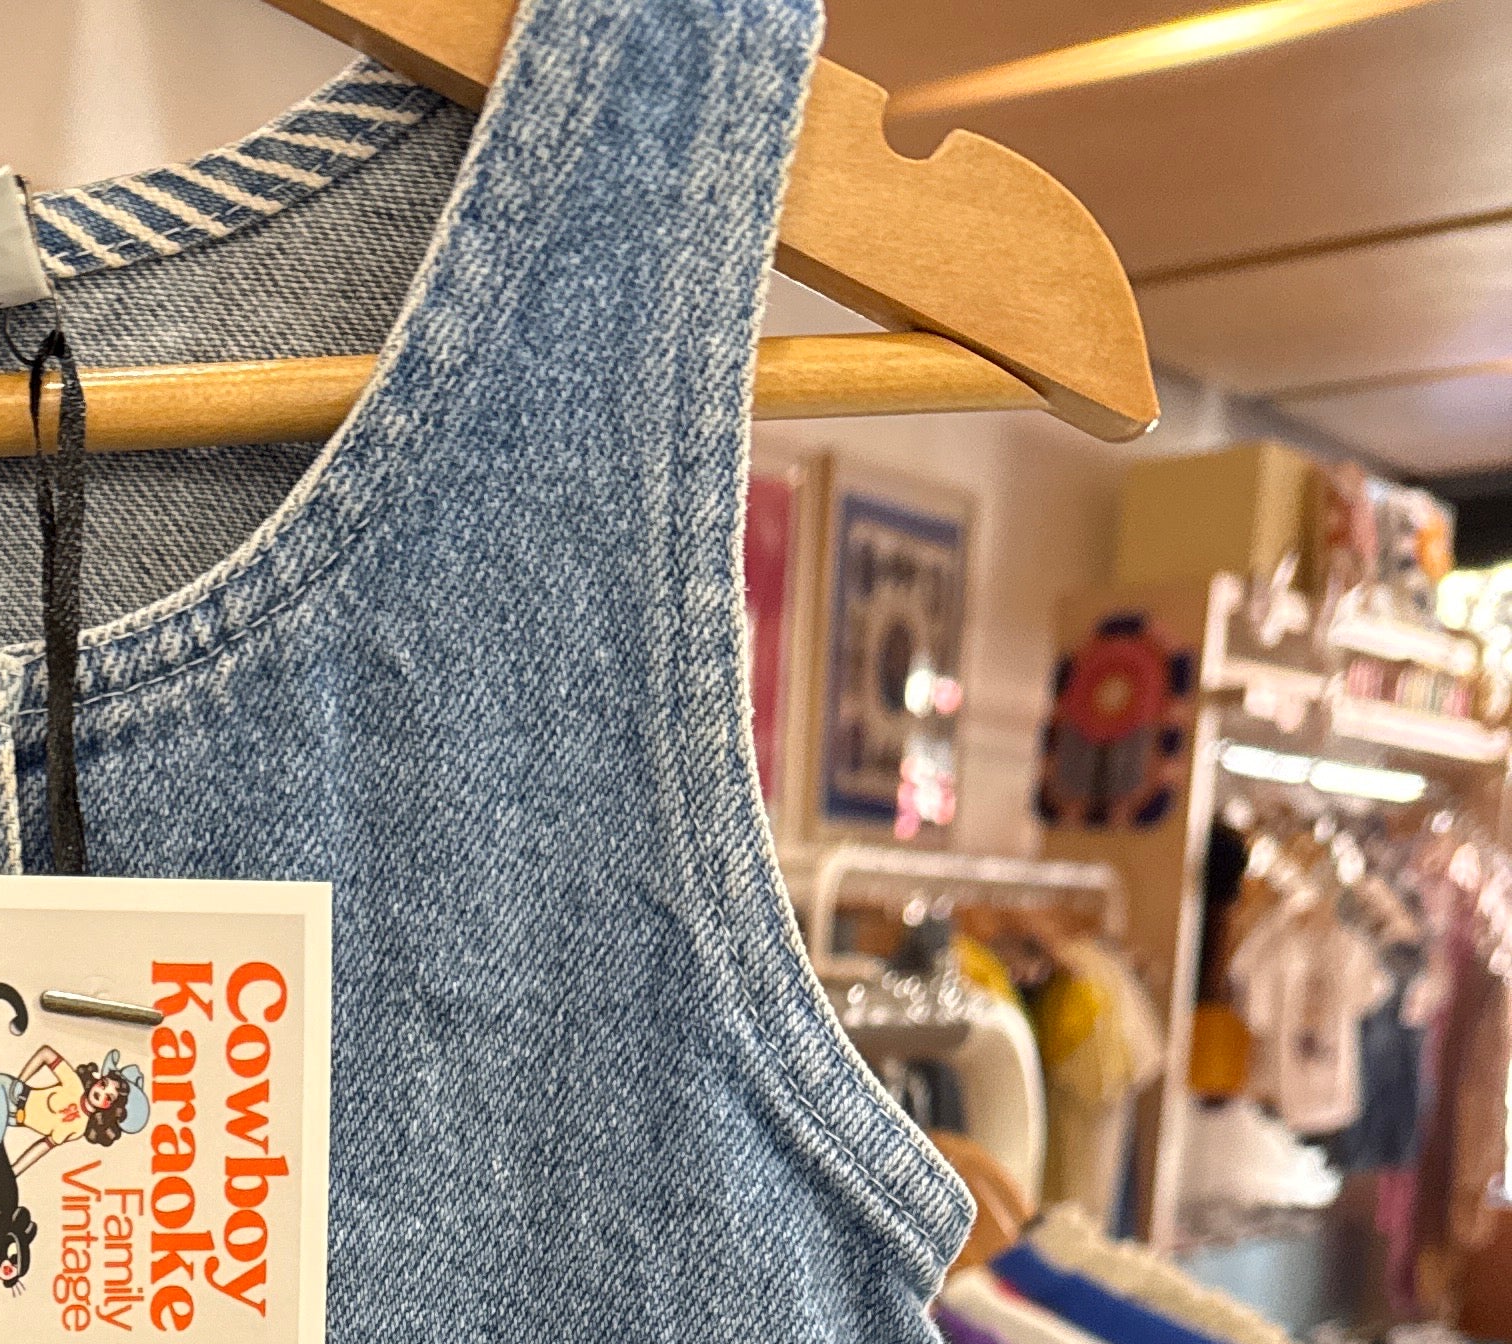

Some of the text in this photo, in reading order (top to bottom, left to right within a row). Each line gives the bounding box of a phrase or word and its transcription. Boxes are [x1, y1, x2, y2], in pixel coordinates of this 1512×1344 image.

[53, 1160, 102, 1332] Vintage
[100, 1187, 145, 1332] Family
[150, 960, 214, 1332] Karaoke
[206, 960, 289, 1318] Cowboy
